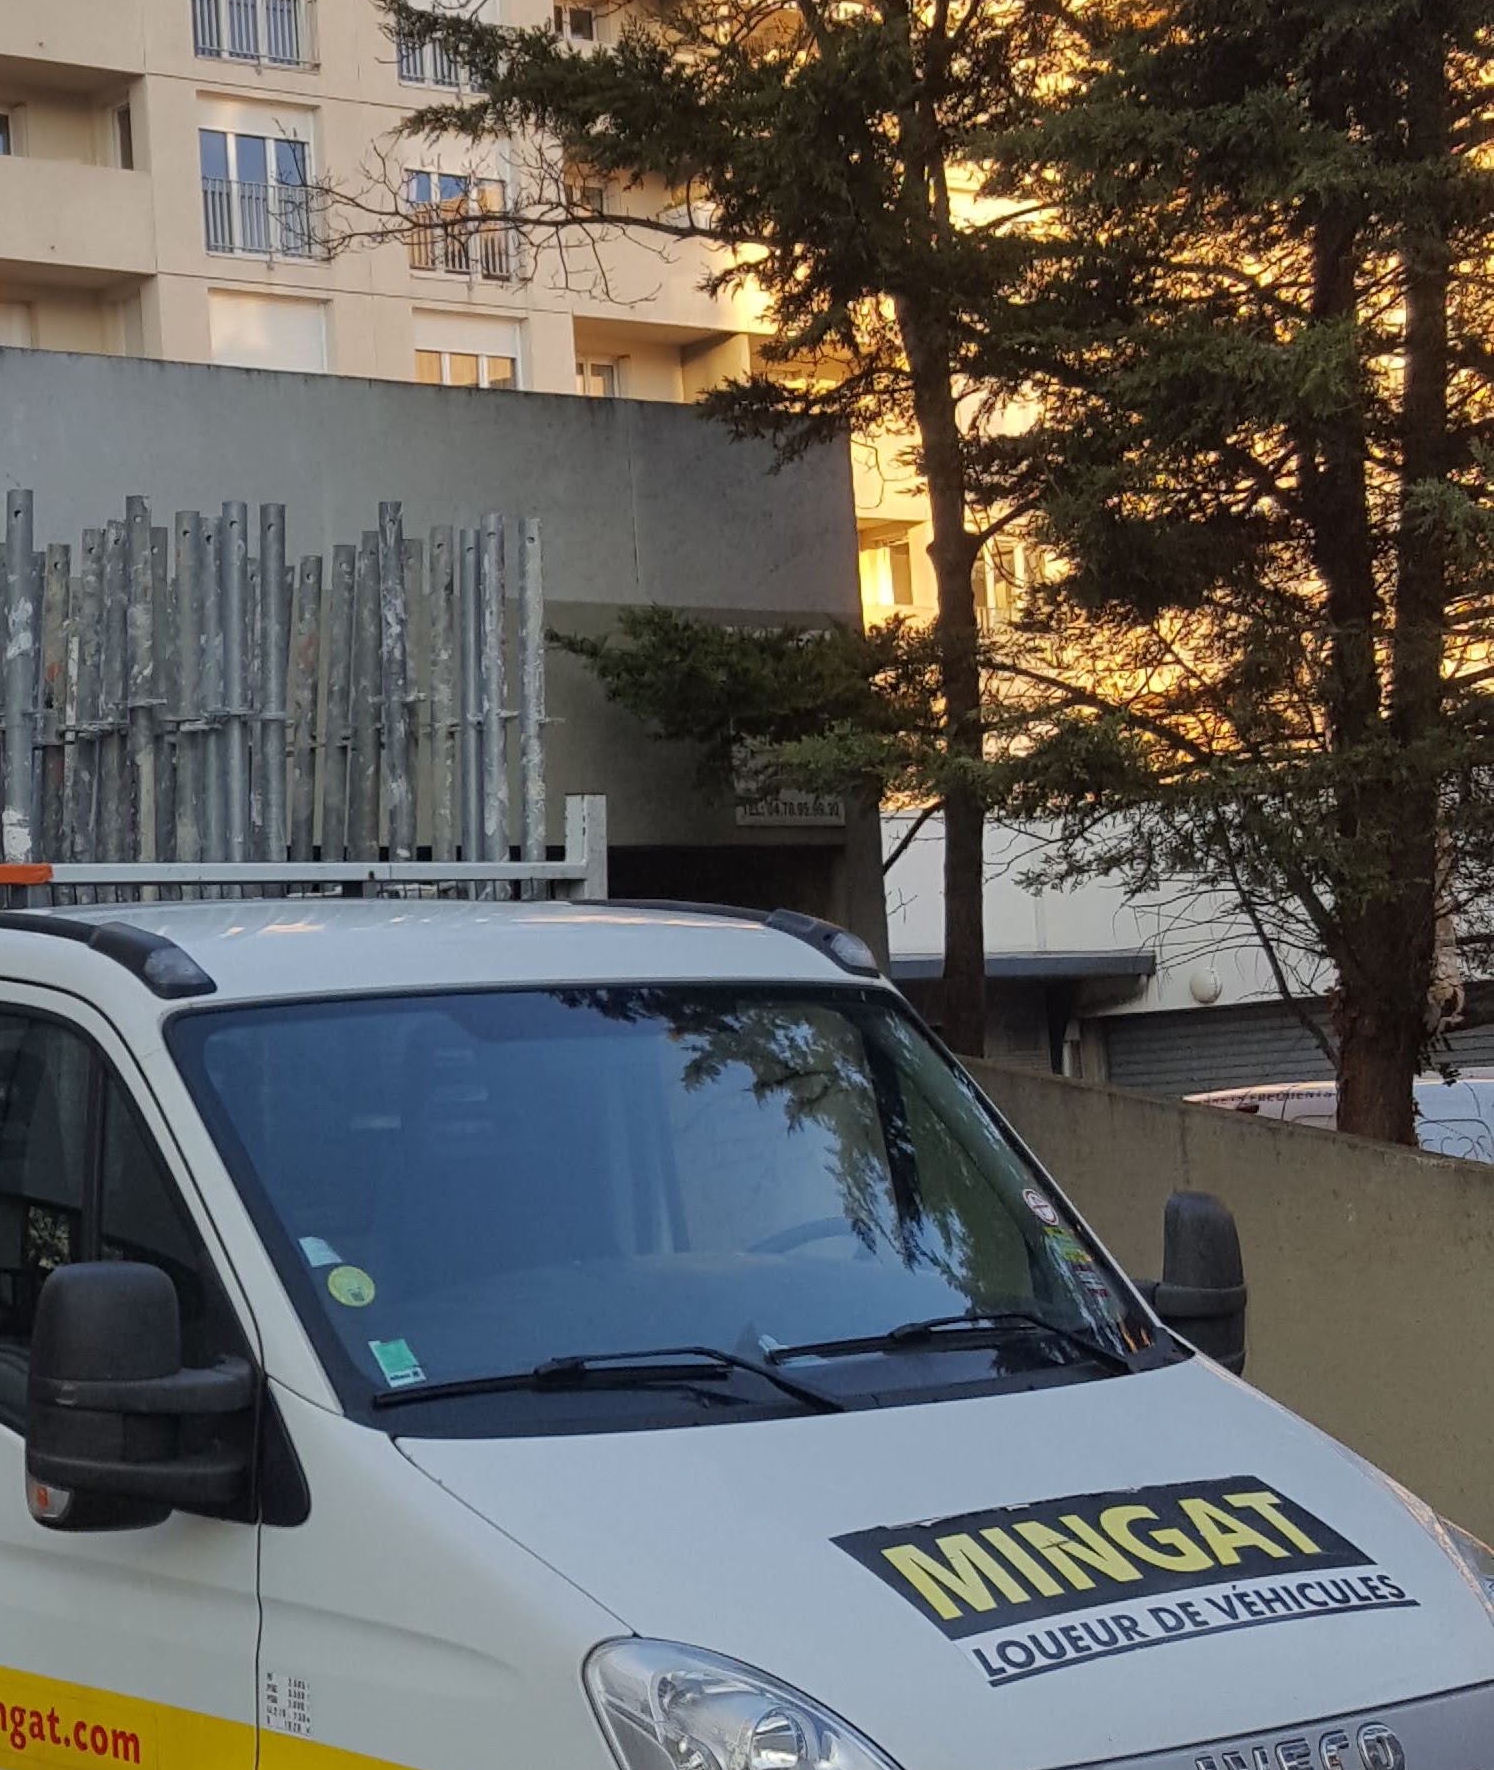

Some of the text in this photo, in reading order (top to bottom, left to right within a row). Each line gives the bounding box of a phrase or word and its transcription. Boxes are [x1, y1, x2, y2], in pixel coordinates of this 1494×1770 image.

[881, 1491, 1323, 1620] MINGAT
[971, 1573, 1407, 1677] LOUEUR DE VÉHICULES
